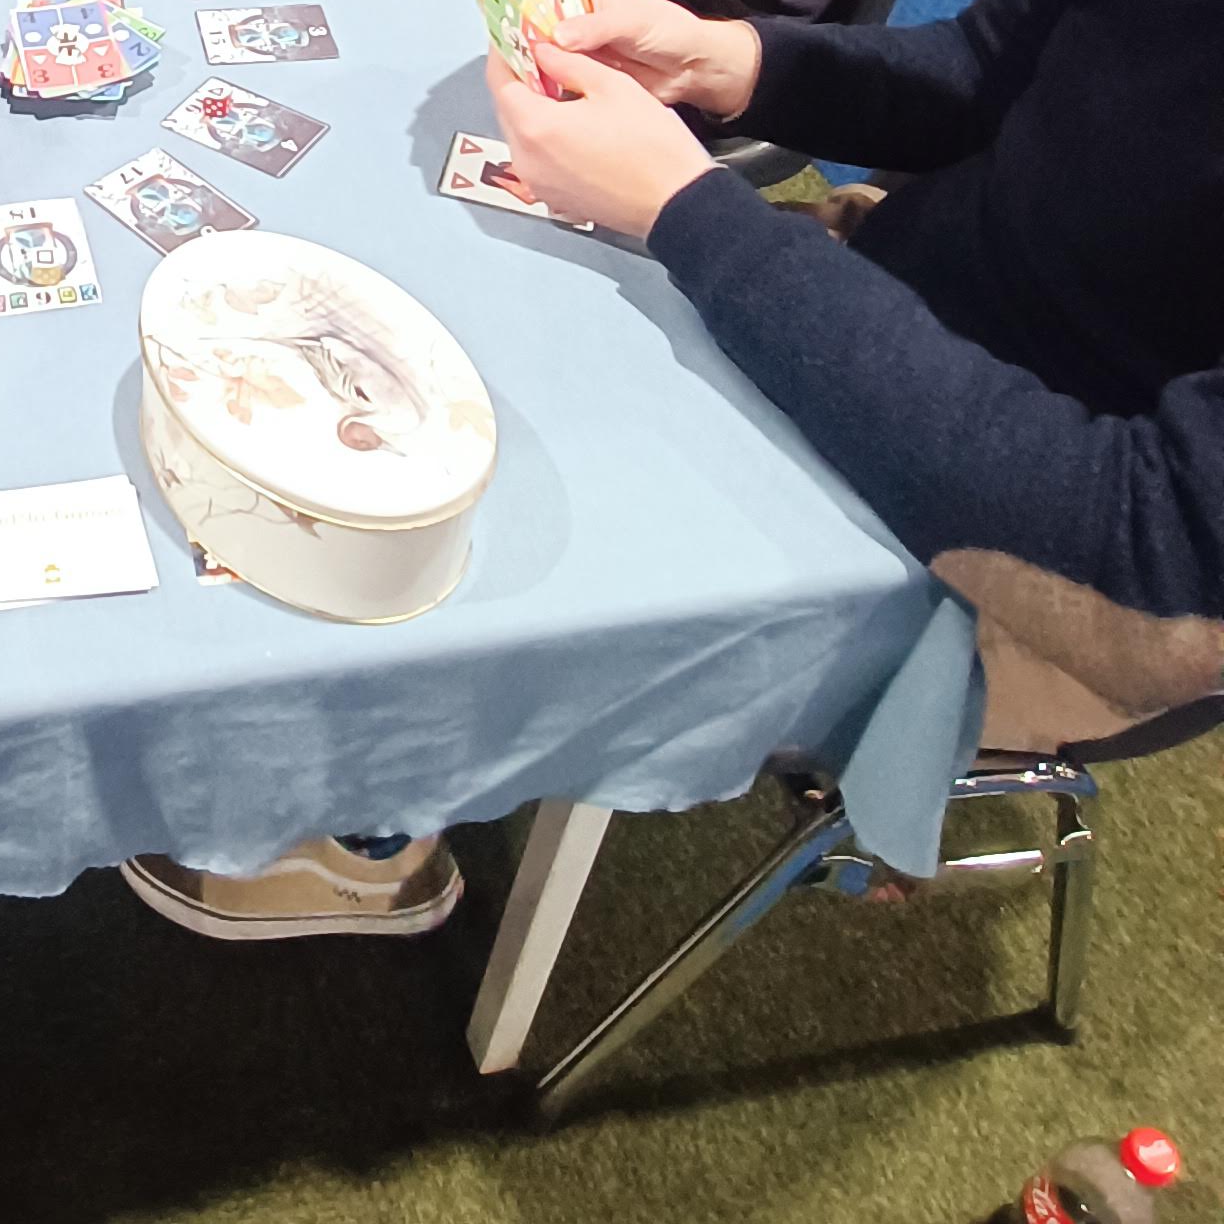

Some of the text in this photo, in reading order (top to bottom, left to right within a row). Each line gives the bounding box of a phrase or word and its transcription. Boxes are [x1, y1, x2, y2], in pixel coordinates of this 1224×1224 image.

[129, 41, 151, 58] 2
[32, 68, 50, 84] 3
[97, 63, 115, 79] 3
